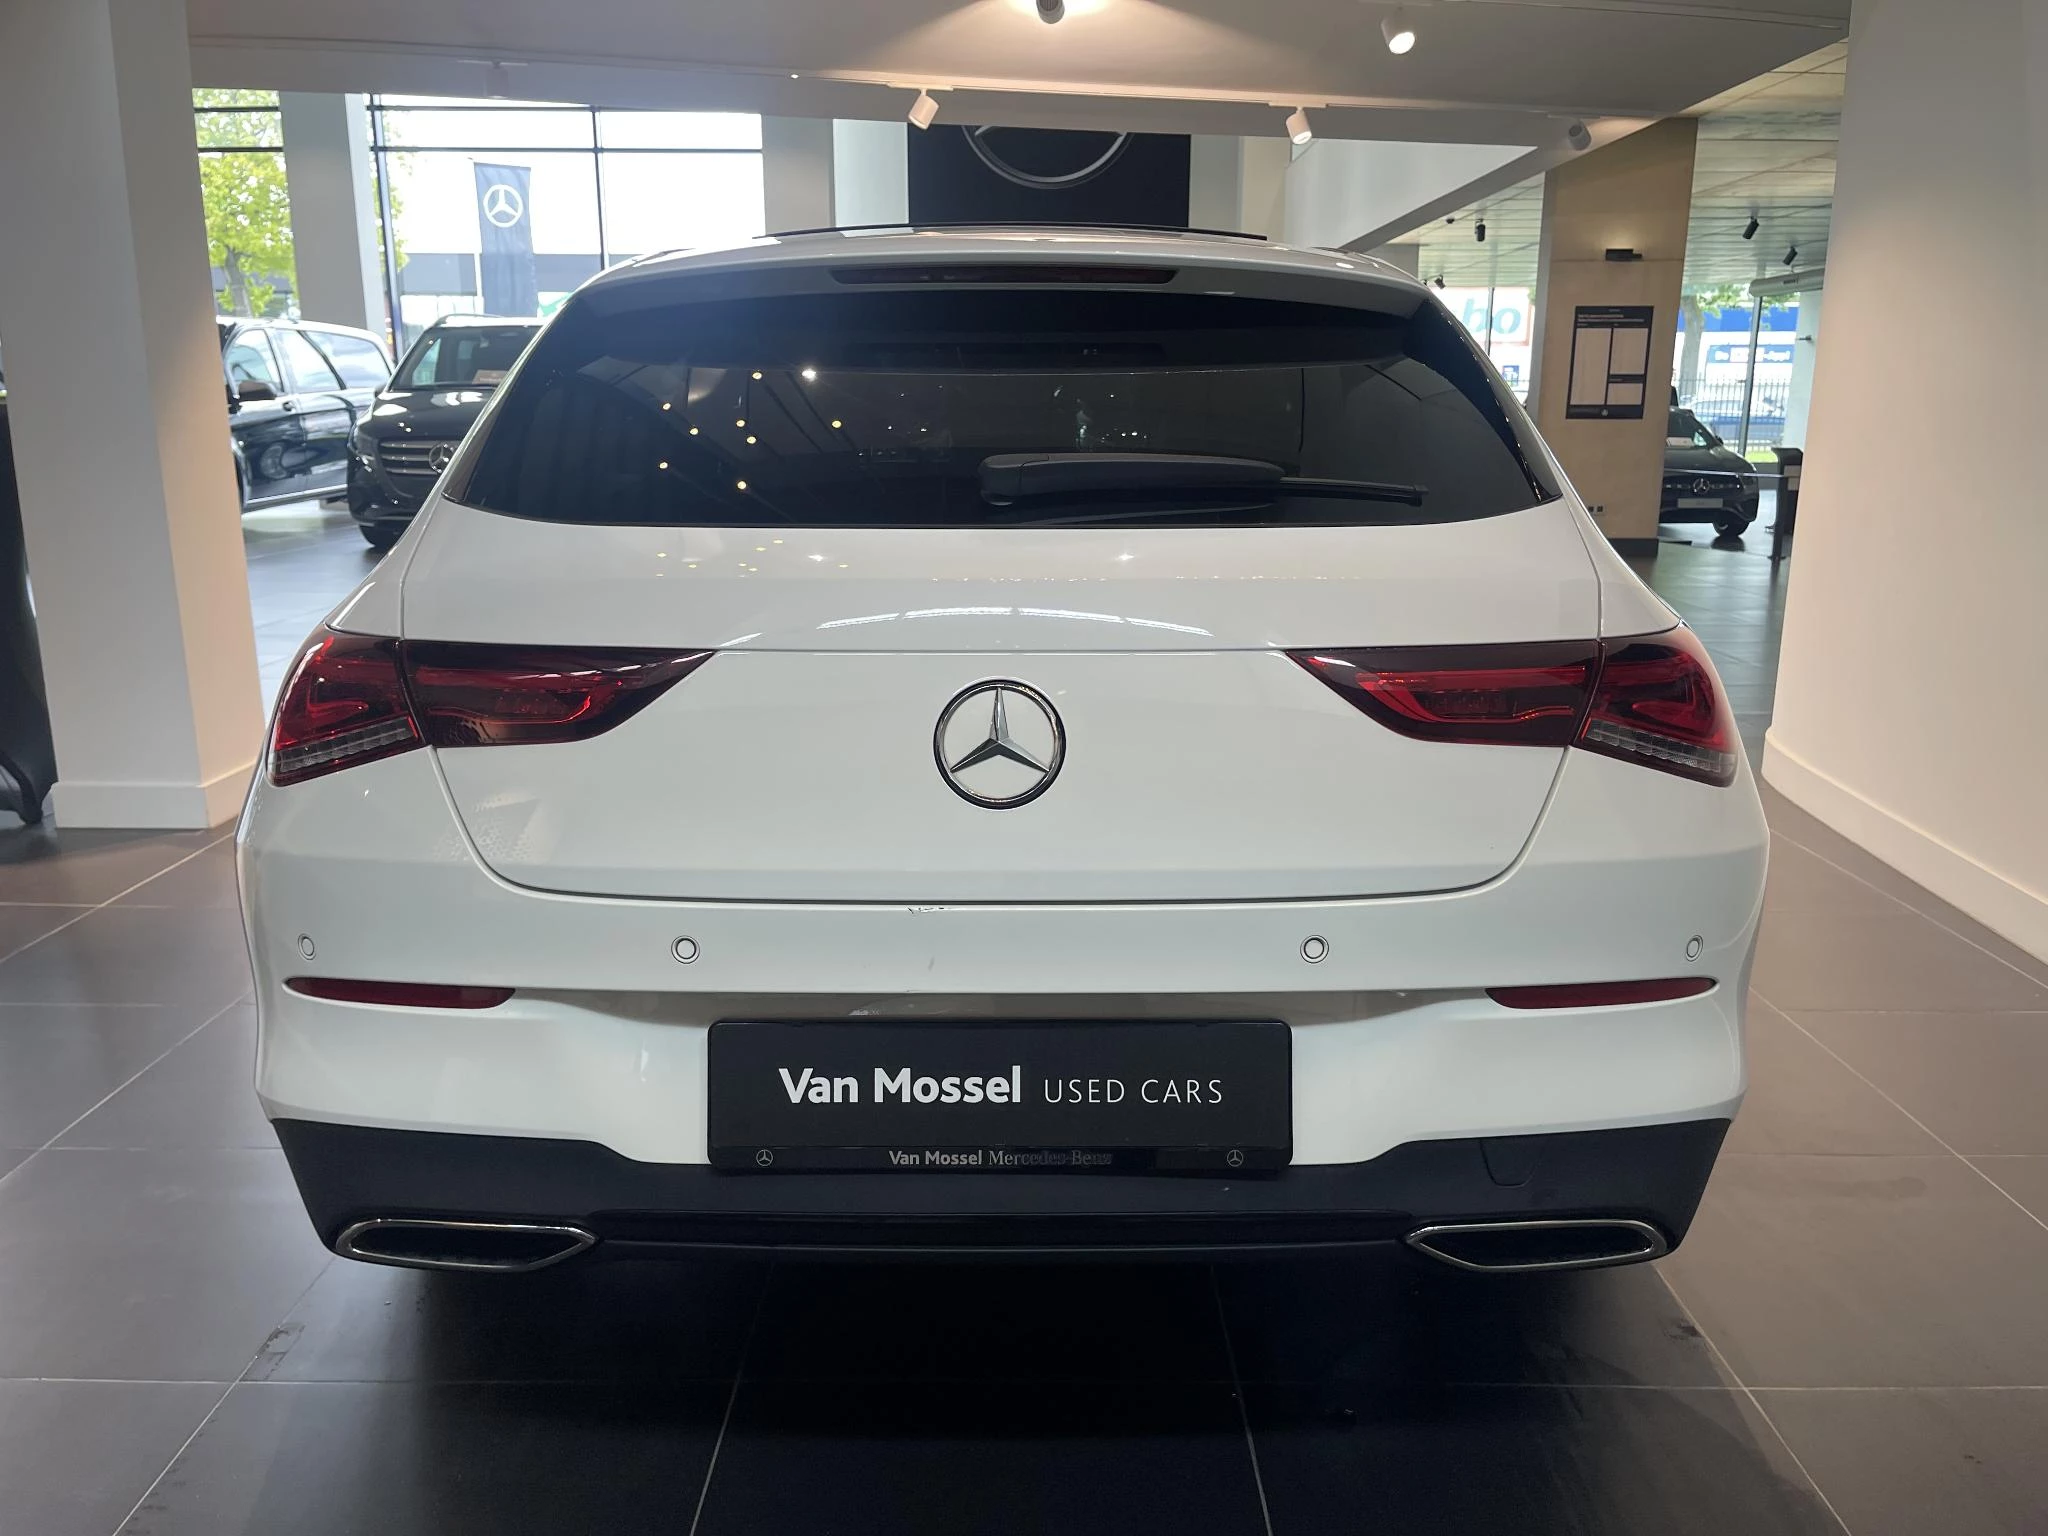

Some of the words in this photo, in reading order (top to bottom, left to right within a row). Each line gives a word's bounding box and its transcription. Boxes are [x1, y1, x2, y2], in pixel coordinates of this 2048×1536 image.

[778, 1067, 859, 1104] Van
[874, 1064, 1021, 1104] Mossel
[1044, 1078, 1125, 1104] USED
[1141, 1078, 1222, 1104] CARS
[888, 1150, 920, 1165] Van
[925, 1149, 983, 1165] Mossel
[988, 1150, 1113, 1166] Mercedes-Benz
